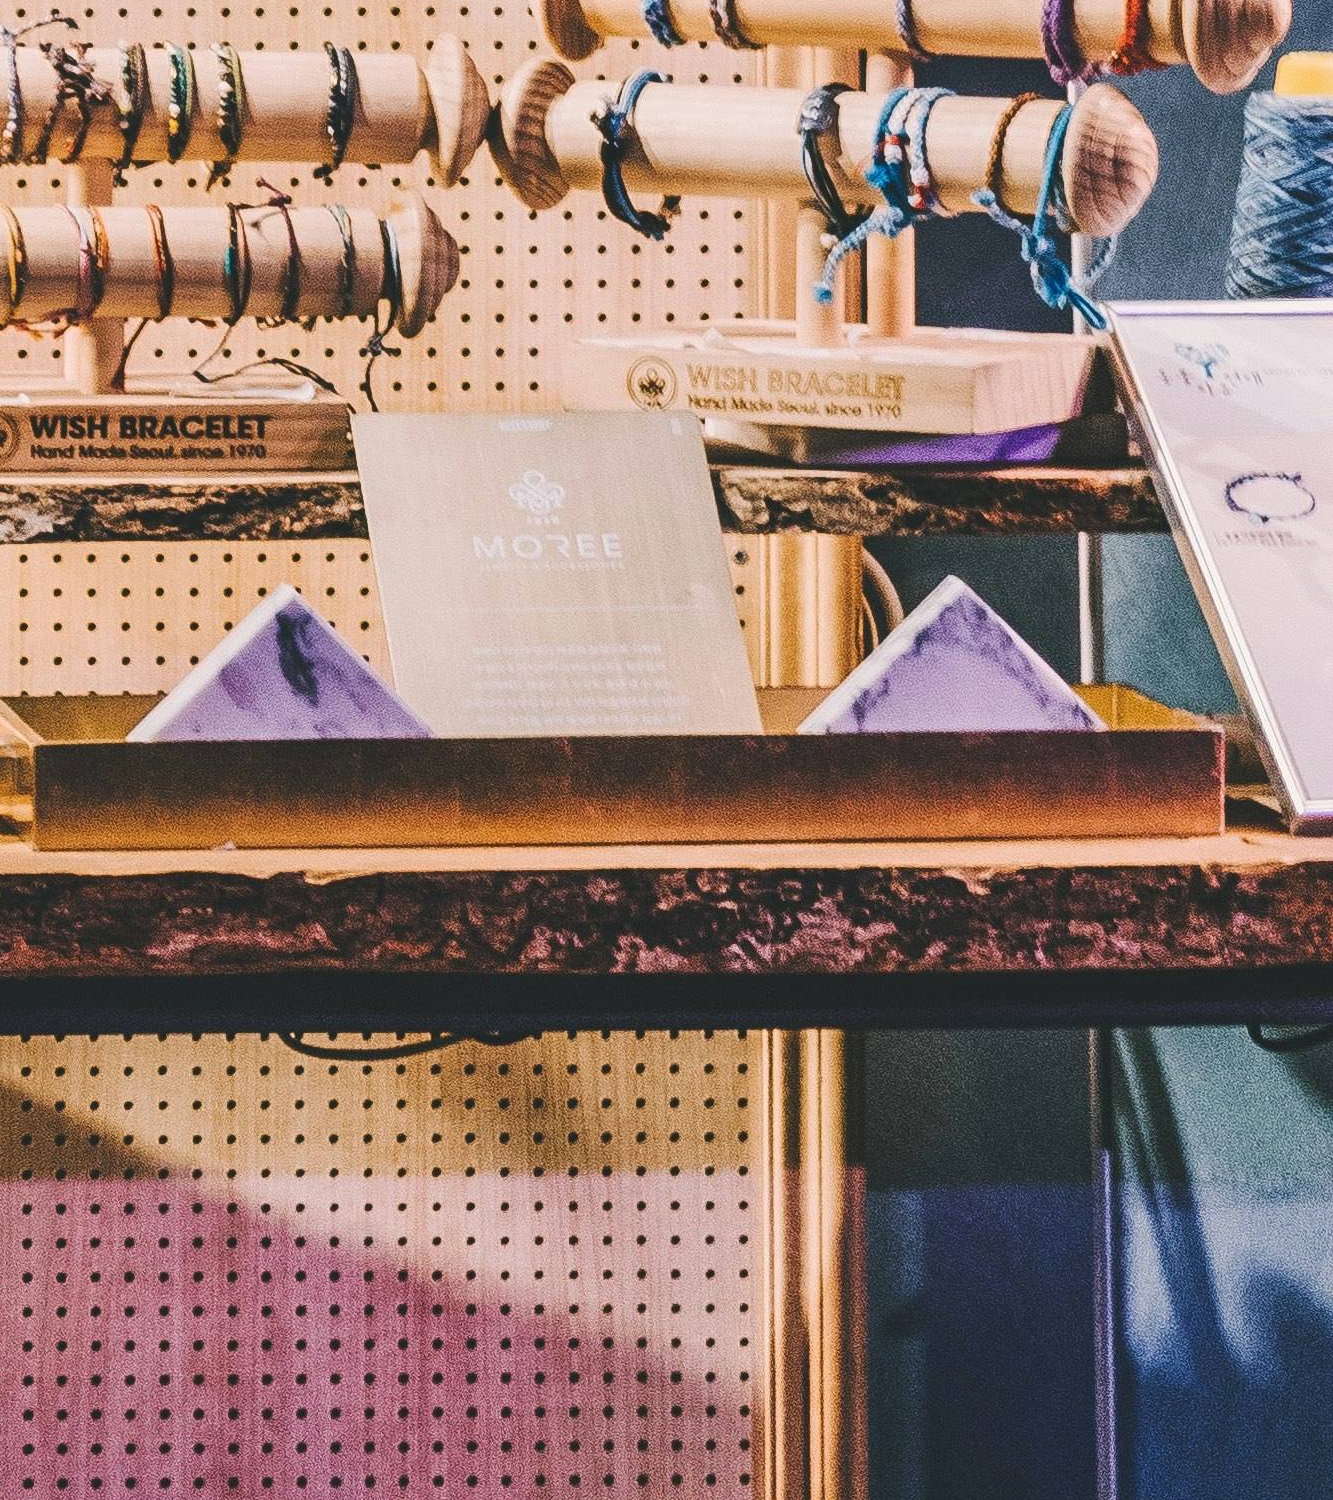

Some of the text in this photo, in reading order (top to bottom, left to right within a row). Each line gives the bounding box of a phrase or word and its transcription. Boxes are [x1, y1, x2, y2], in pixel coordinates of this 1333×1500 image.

[686, 363, 906, 402] WISH BRACELET
[30, 413, 271, 440] WISH BRACELET
[30, 444, 74, 459] Hand
[79, 444, 126, 459] Made
[181, 444, 225, 459] since
[228, 443, 267, 459] 1970
[472, 532, 623, 559] MOREE
